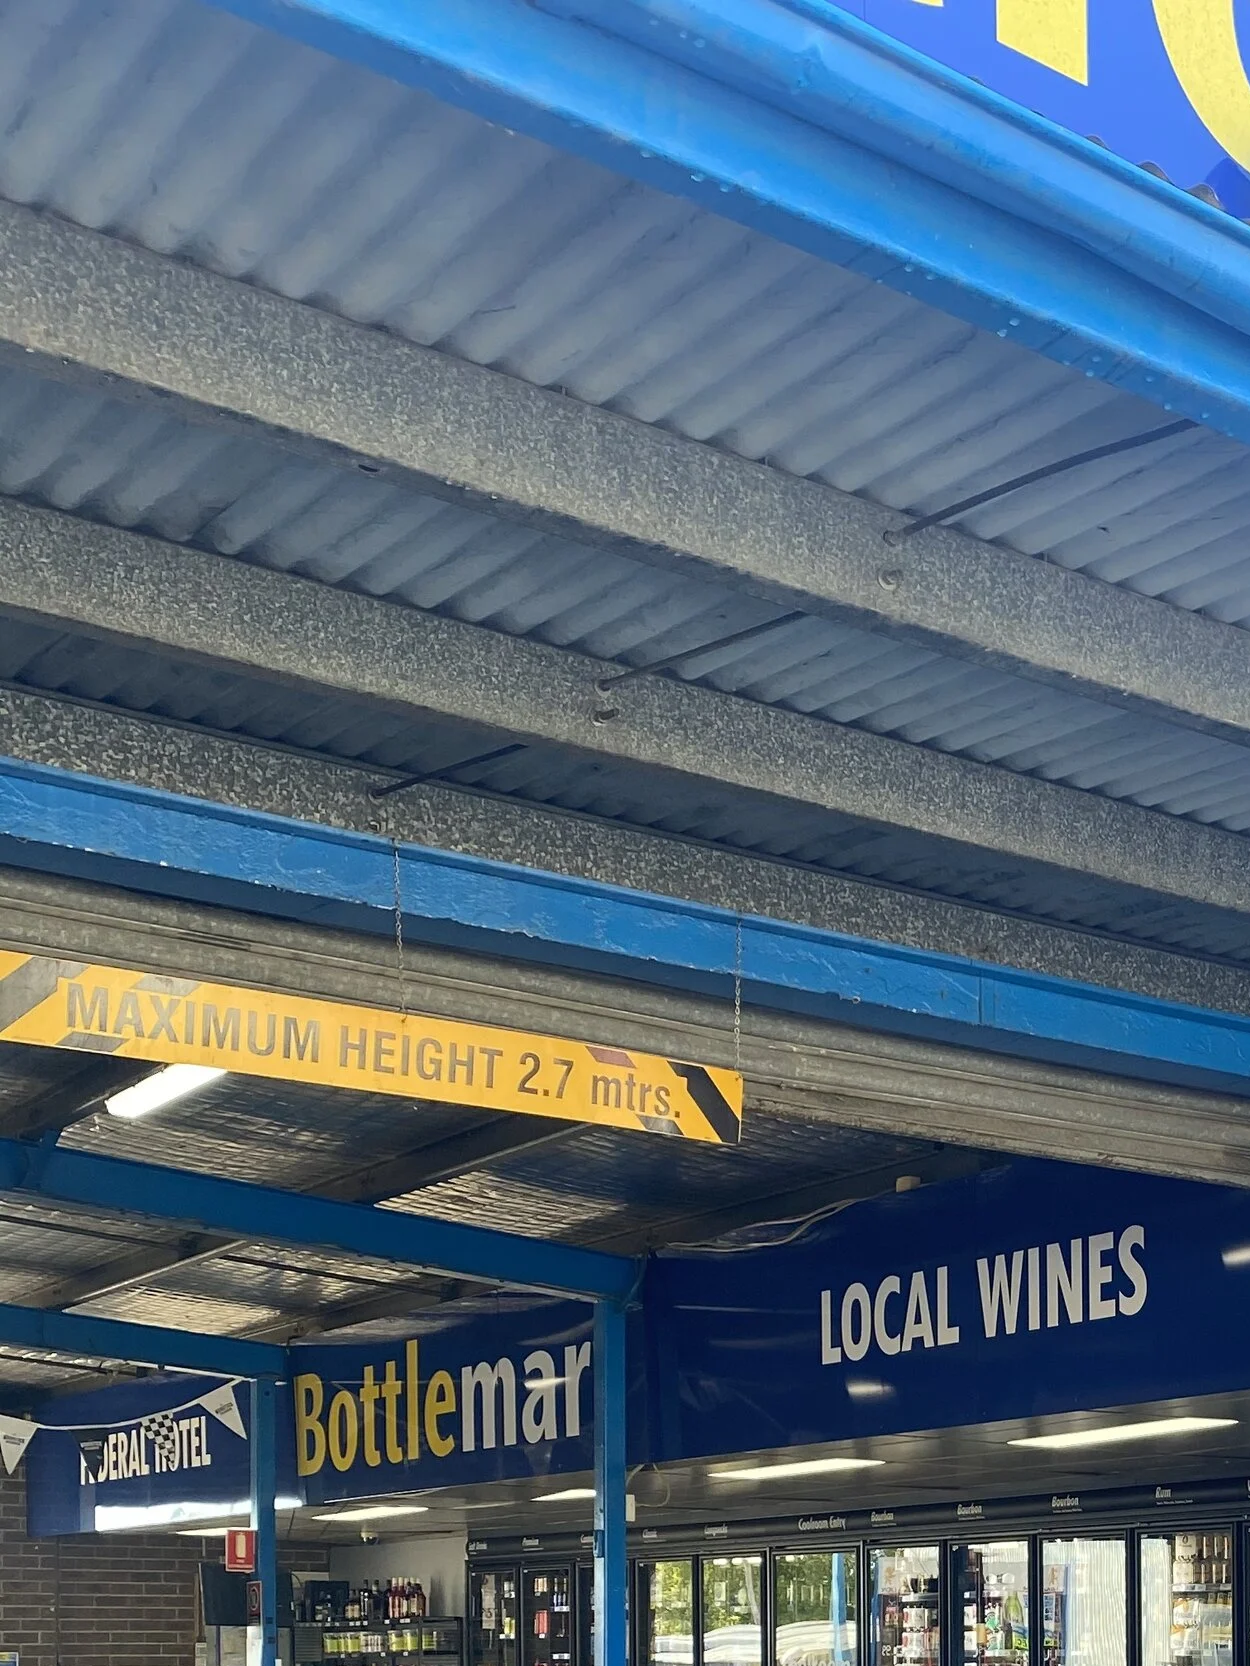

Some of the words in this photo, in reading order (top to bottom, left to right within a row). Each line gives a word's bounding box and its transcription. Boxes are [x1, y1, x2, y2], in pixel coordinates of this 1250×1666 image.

[64, 981, 321, 1065] MAXIMUM
[338, 1024, 504, 1089] HEIGHT
[517, 1051, 575, 1100] 2.7
[590, 1070, 682, 1119] mtrs.
[820, 1264, 961, 1366] LOCAL
[975, 1224, 1149, 1340] WINES
[1155, 1487, 1172, 1499] Rum
[1051, 1496, 1079, 1508] Bourbon
[957, 1504, 982, 1516] Bourbon
[798, 1517, 828, 1532] Coolroom
[828, 1515, 846, 1531] Entry
